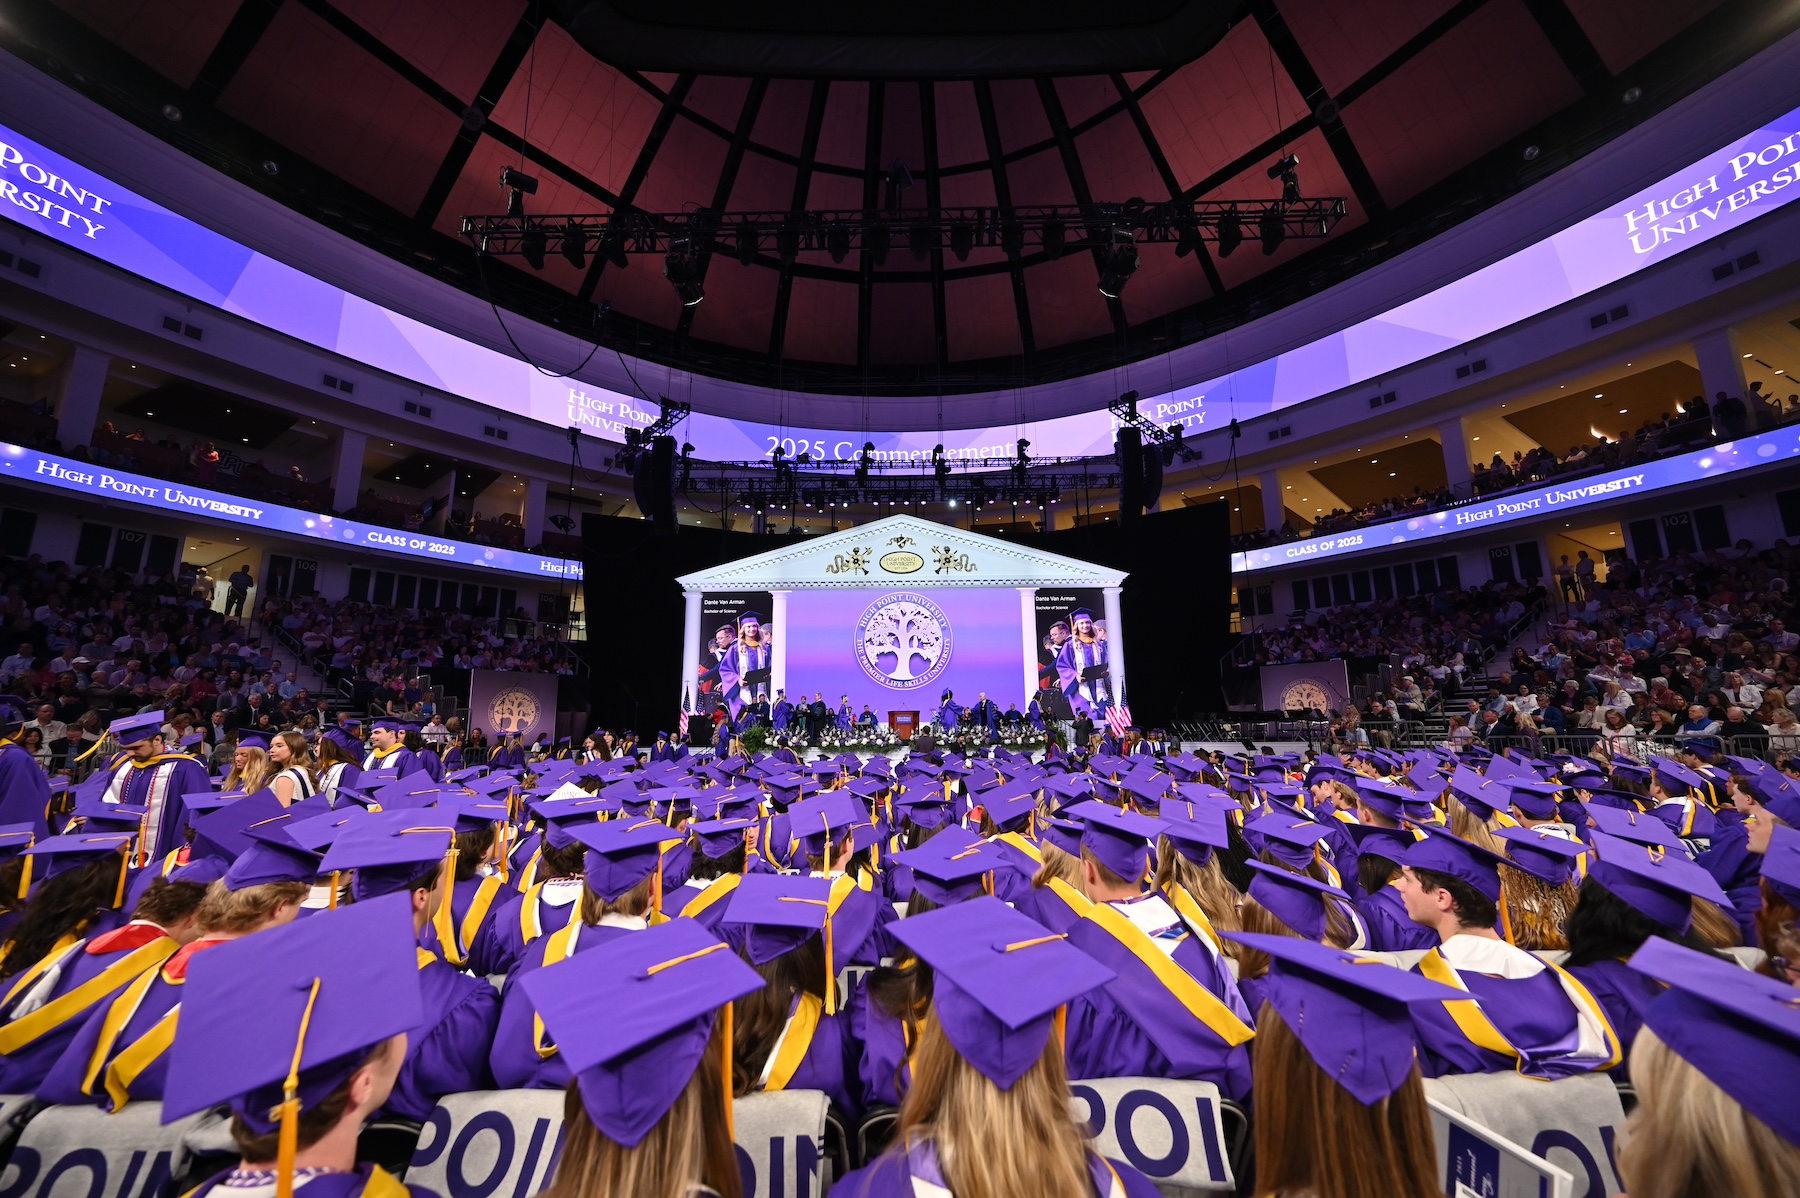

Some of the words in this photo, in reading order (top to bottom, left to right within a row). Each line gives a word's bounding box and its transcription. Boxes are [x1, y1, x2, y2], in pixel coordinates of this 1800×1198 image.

[0, 141, 112, 215] POINT
[1624, 175, 1720, 234] HIGH
[567, 388, 613, 415] HIGH
[618, 403, 661, 426] POIN
[1156, 396, 1205, 418] POINT
[765, 436, 825, 460] 2025
[35, 459, 94, 486] HIGH
[98, 474, 158, 499] POINT
[164, 488, 263, 520] UNIVERSITY
[1455, 508, 1494, 526] HIGH
[1496, 498, 1542, 517] POINT
[1544, 474, 1645, 506] UNIVERSITY
[1663, 513, 1689, 527] 102
[120, 530, 147, 543] 107
[367, 531, 406, 547] CLASS
[409, 538, 427, 550] OF
[428, 542, 456, 555] 2025
[1286, 544, 1318, 558] CLASS
[1319, 540, 1336, 552] OF
[1337, 535, 1363, 548] 2025
[1490, 547, 1510, 558] 103
[296, 560, 317, 571] 106
[540, 560, 568, 574] HIGH
[540, 594, 554, 603] 106
[1256, 587, 1271, 595] 103
[860, 606, 878, 629] HIGH
[877, 594, 904, 608] POINT
[905, 594, 948, 628] UNIVERSITY
[857, 638, 865, 655] THE
[860, 653, 885, 683] PREMIER
[928, 638, 950, 678] UNIVERSITY
[885, 678, 903, 687] LIFE
[905, 675, 929, 687] SKILLS
